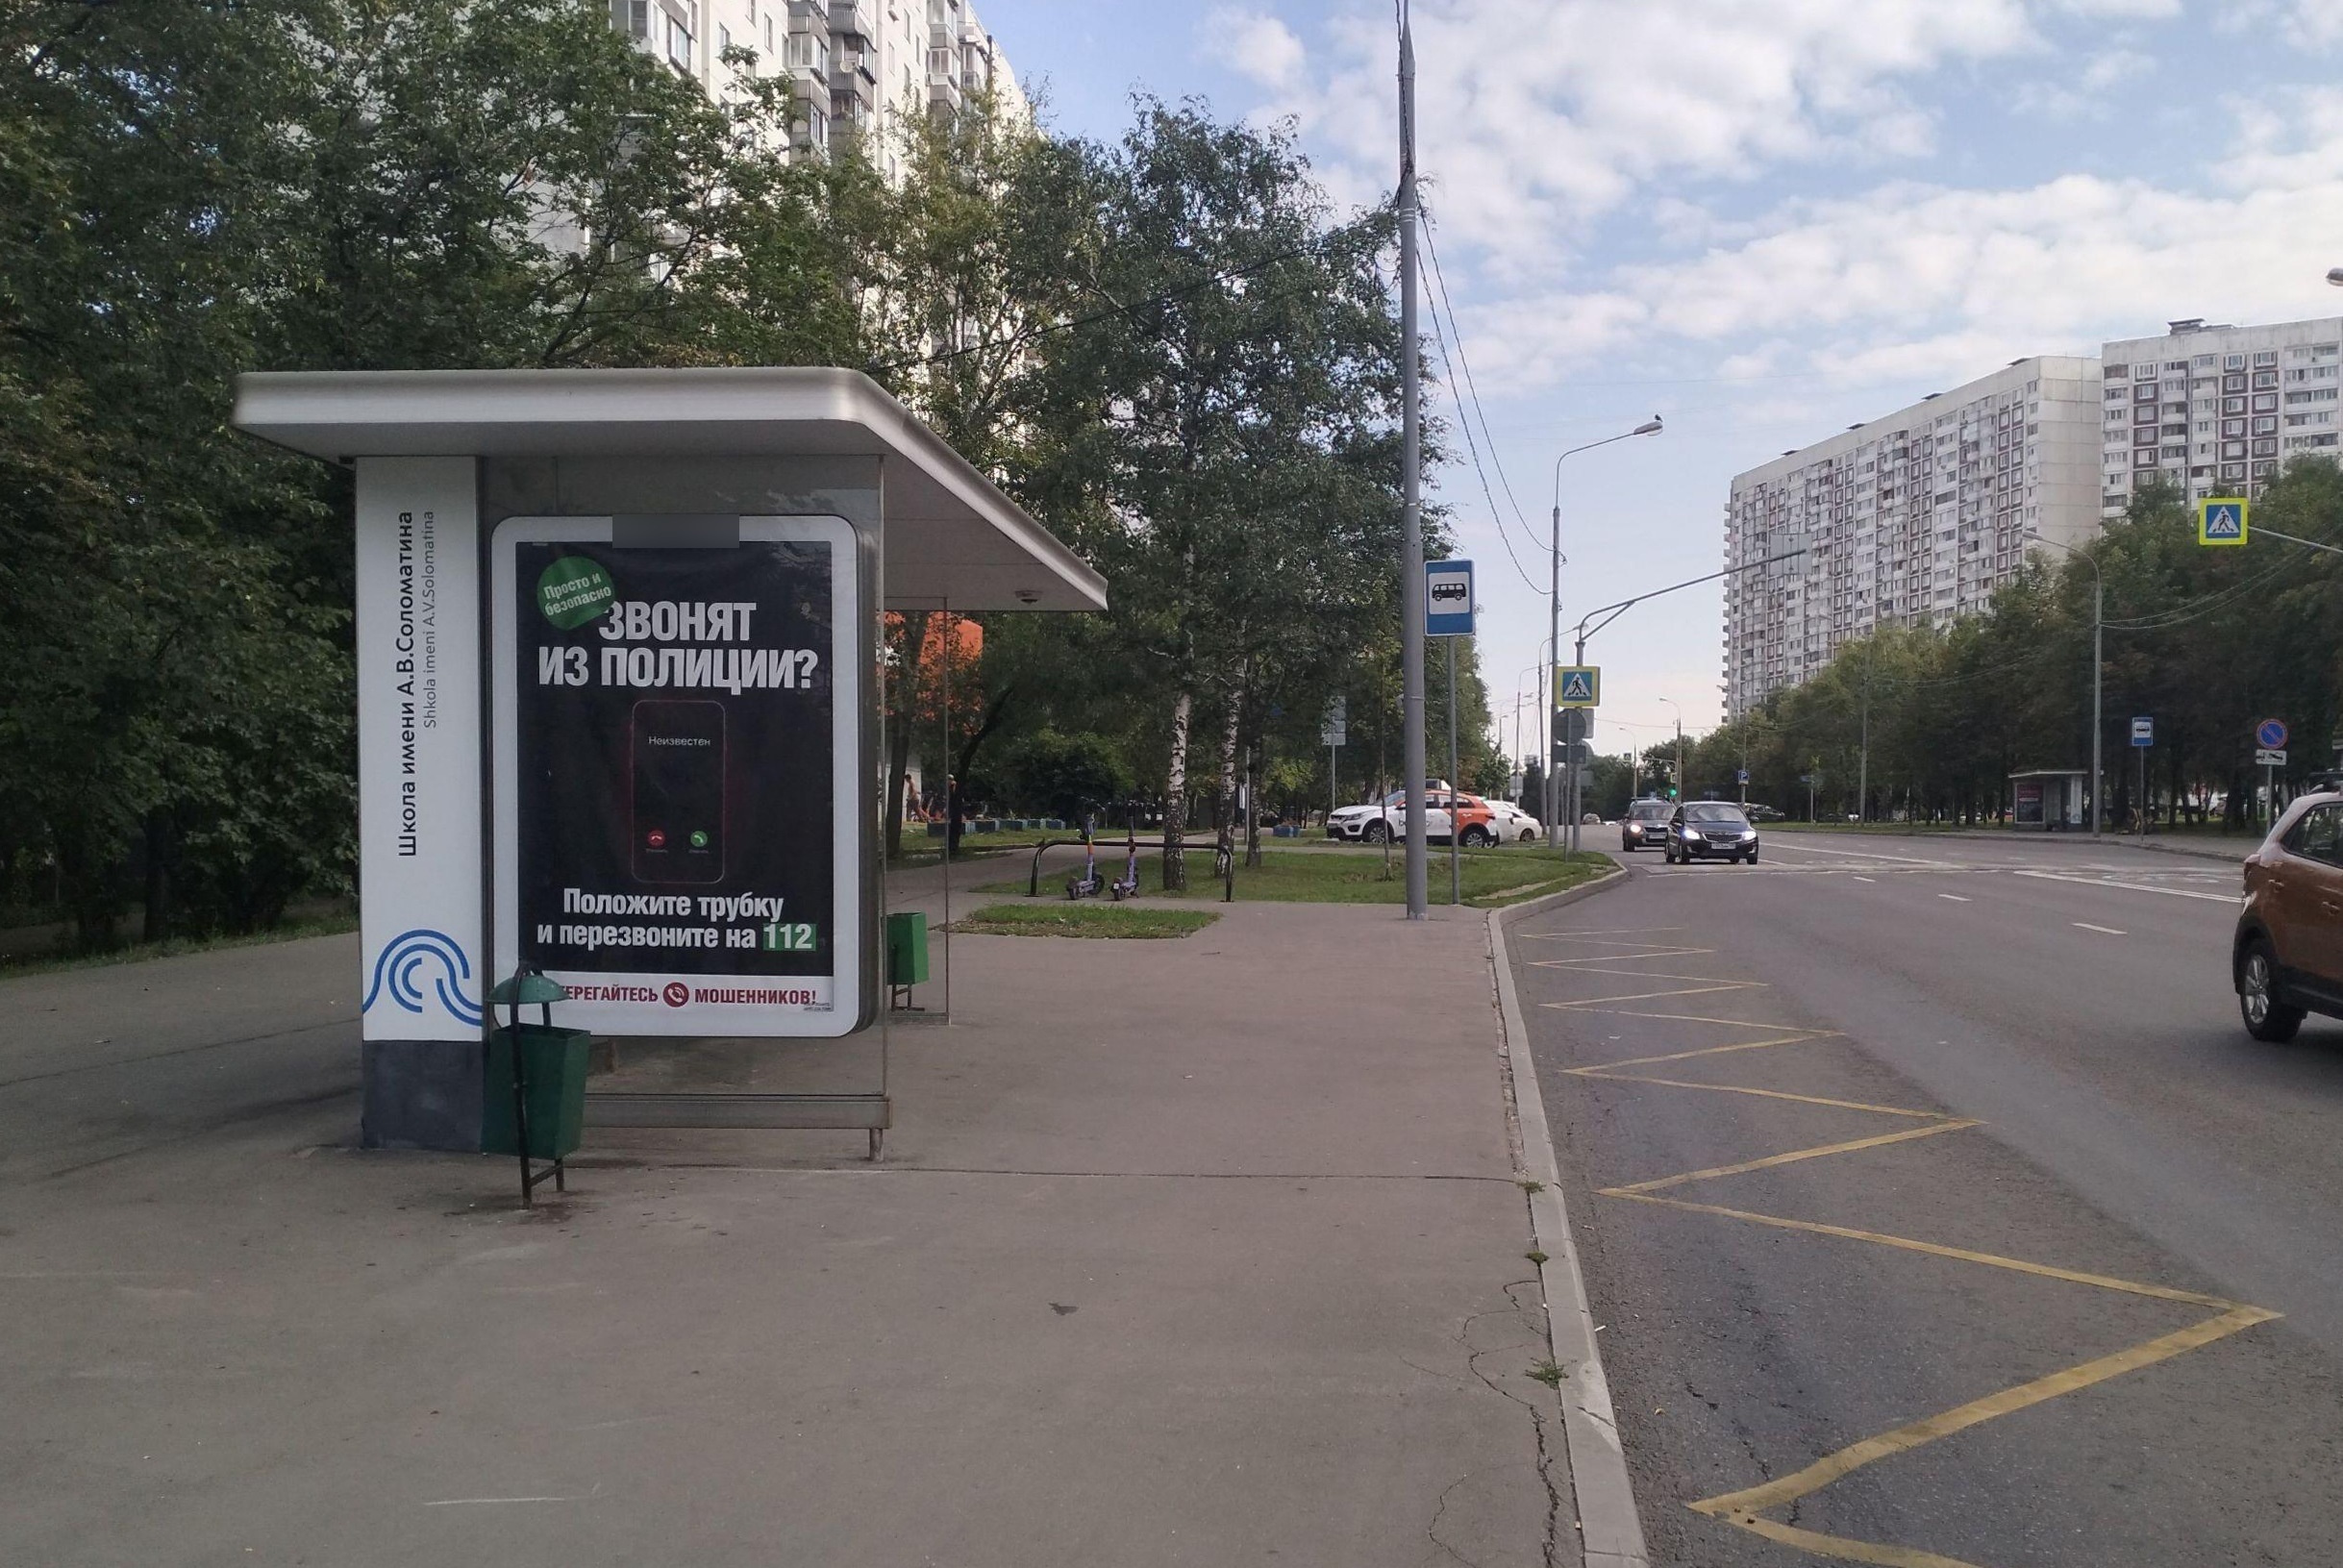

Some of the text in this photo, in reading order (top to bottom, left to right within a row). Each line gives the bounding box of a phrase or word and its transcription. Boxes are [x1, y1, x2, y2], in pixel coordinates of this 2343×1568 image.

[543, 573, 602, 600] Просто и
[544, 586, 612, 616] безопасно
[421, 510, 436, 729] Shkola imeni A.V.Solomatina
[598, 601, 757, 641] ЗВОНЯТ
[396, 511, 416, 857] Школа имени А.В.Соломатина
[538, 646, 818, 695] ИЗ ПОЛИЦИИ?
[648, 735, 711, 746] Неизвестен
[563, 887, 784, 922] Положите трубку
[537, 923, 812, 951] и перезвоните на 112
[560, 983, 817, 1006] ЕРЕГАЙТЕСЬ МОШЕННИКОВ!
